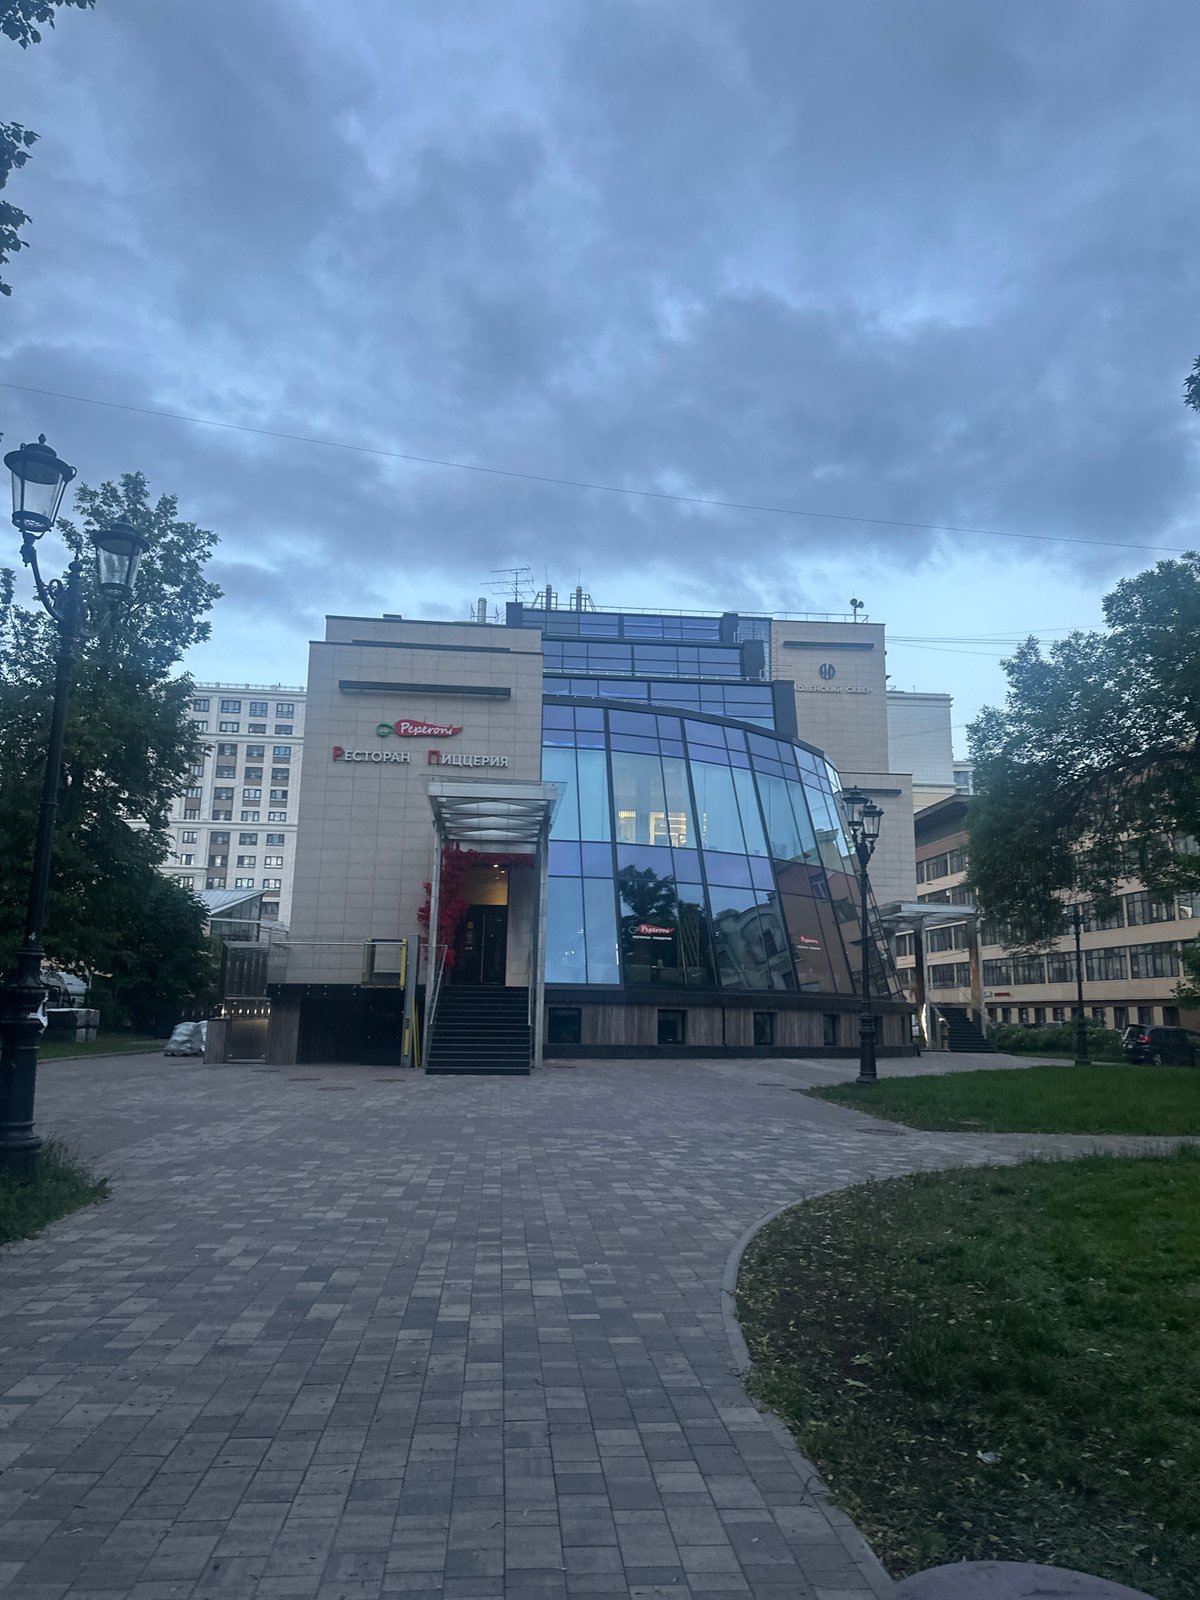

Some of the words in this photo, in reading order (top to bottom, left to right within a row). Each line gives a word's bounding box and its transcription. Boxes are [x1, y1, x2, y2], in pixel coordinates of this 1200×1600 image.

[400, 721, 453, 735] Peperoni
[332, 745, 411, 763] РЕСТОРАН
[427, 749, 509, 768] ПИЦЦЕРИЯ
